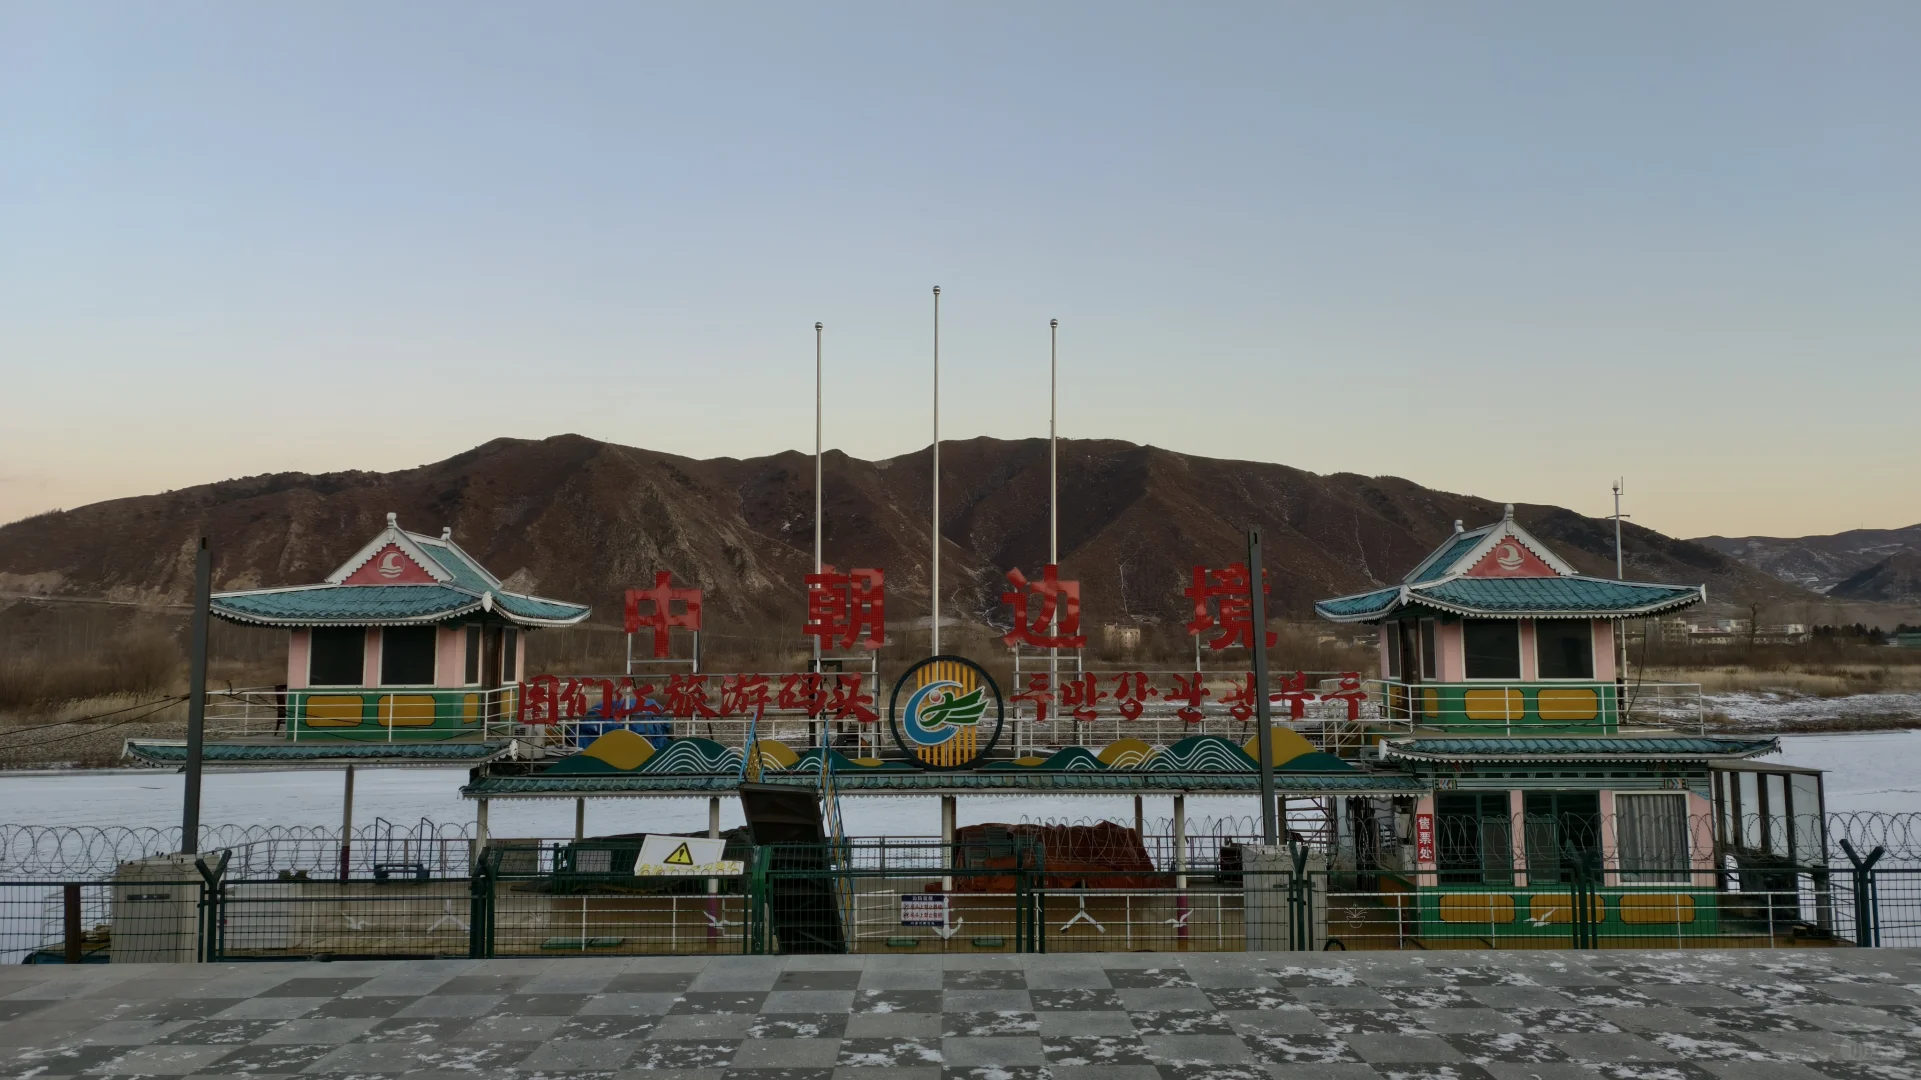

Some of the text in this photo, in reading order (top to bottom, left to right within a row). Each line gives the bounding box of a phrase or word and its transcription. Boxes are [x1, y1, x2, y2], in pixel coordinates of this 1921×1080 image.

[624, 562, 1279, 658] 中朝边境
[516, 673, 881, 726] 图们江旅游码头
[1009, 670, 1368, 723] 두만강관광부두
[1418, 817, 1432, 859] 售票处
